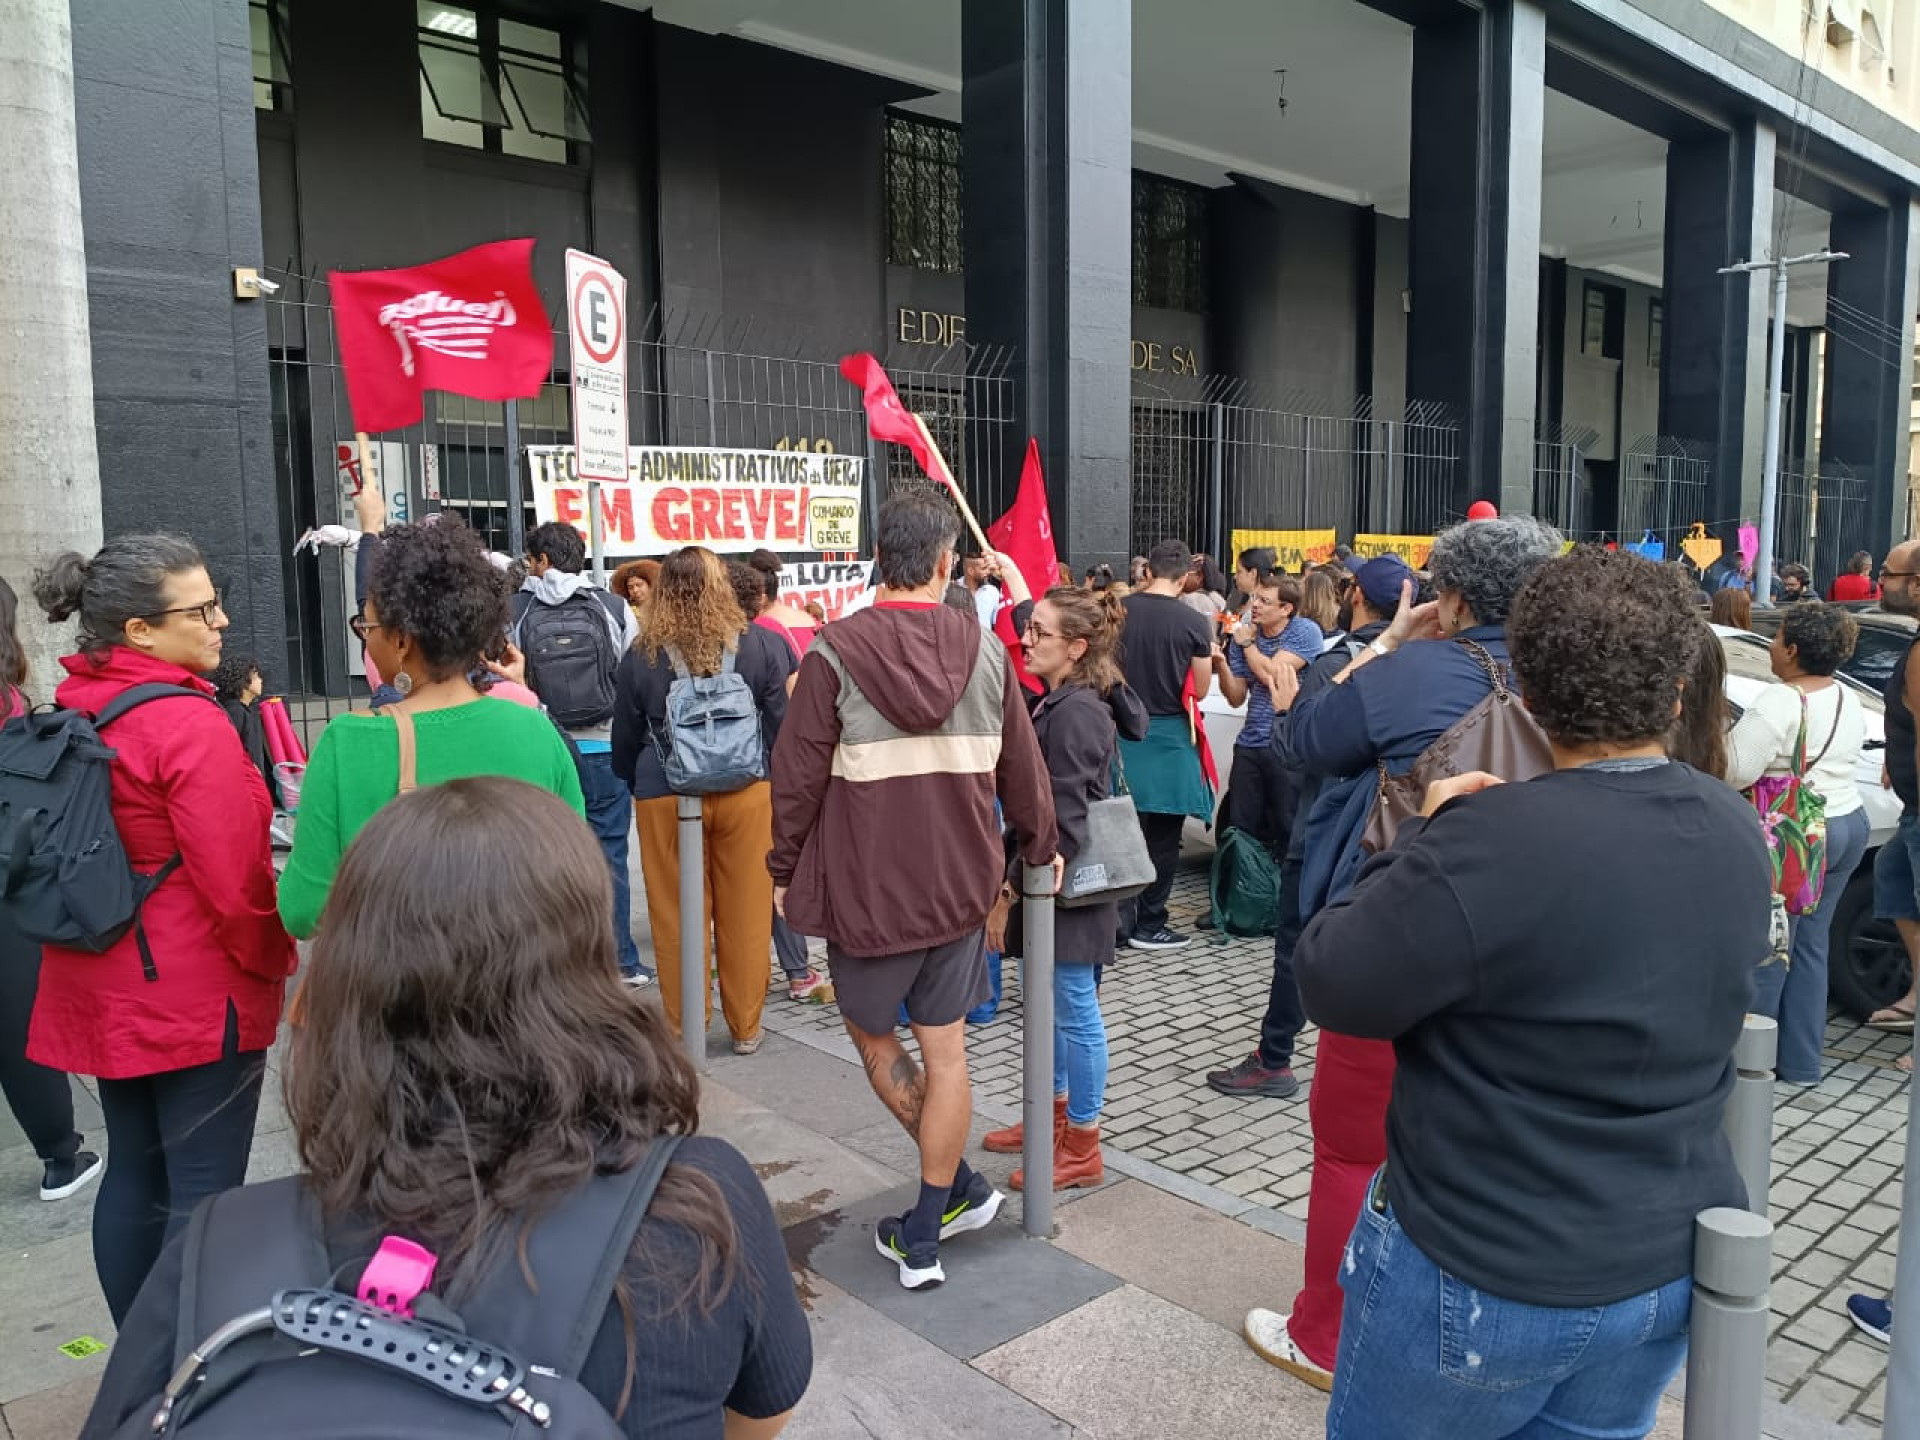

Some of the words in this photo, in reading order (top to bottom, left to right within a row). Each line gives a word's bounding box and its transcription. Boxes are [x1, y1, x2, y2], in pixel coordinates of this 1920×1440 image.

[589, 290, 608, 345] E
[824, 456, 861, 487] UERJ
[554, 488, 636, 542] EM
[652, 486, 811, 545] GREVE!
[812, 504, 855, 519] COMANDO
[816, 530, 852, 545] GREVE
[797, 563, 865, 586] LUTA
